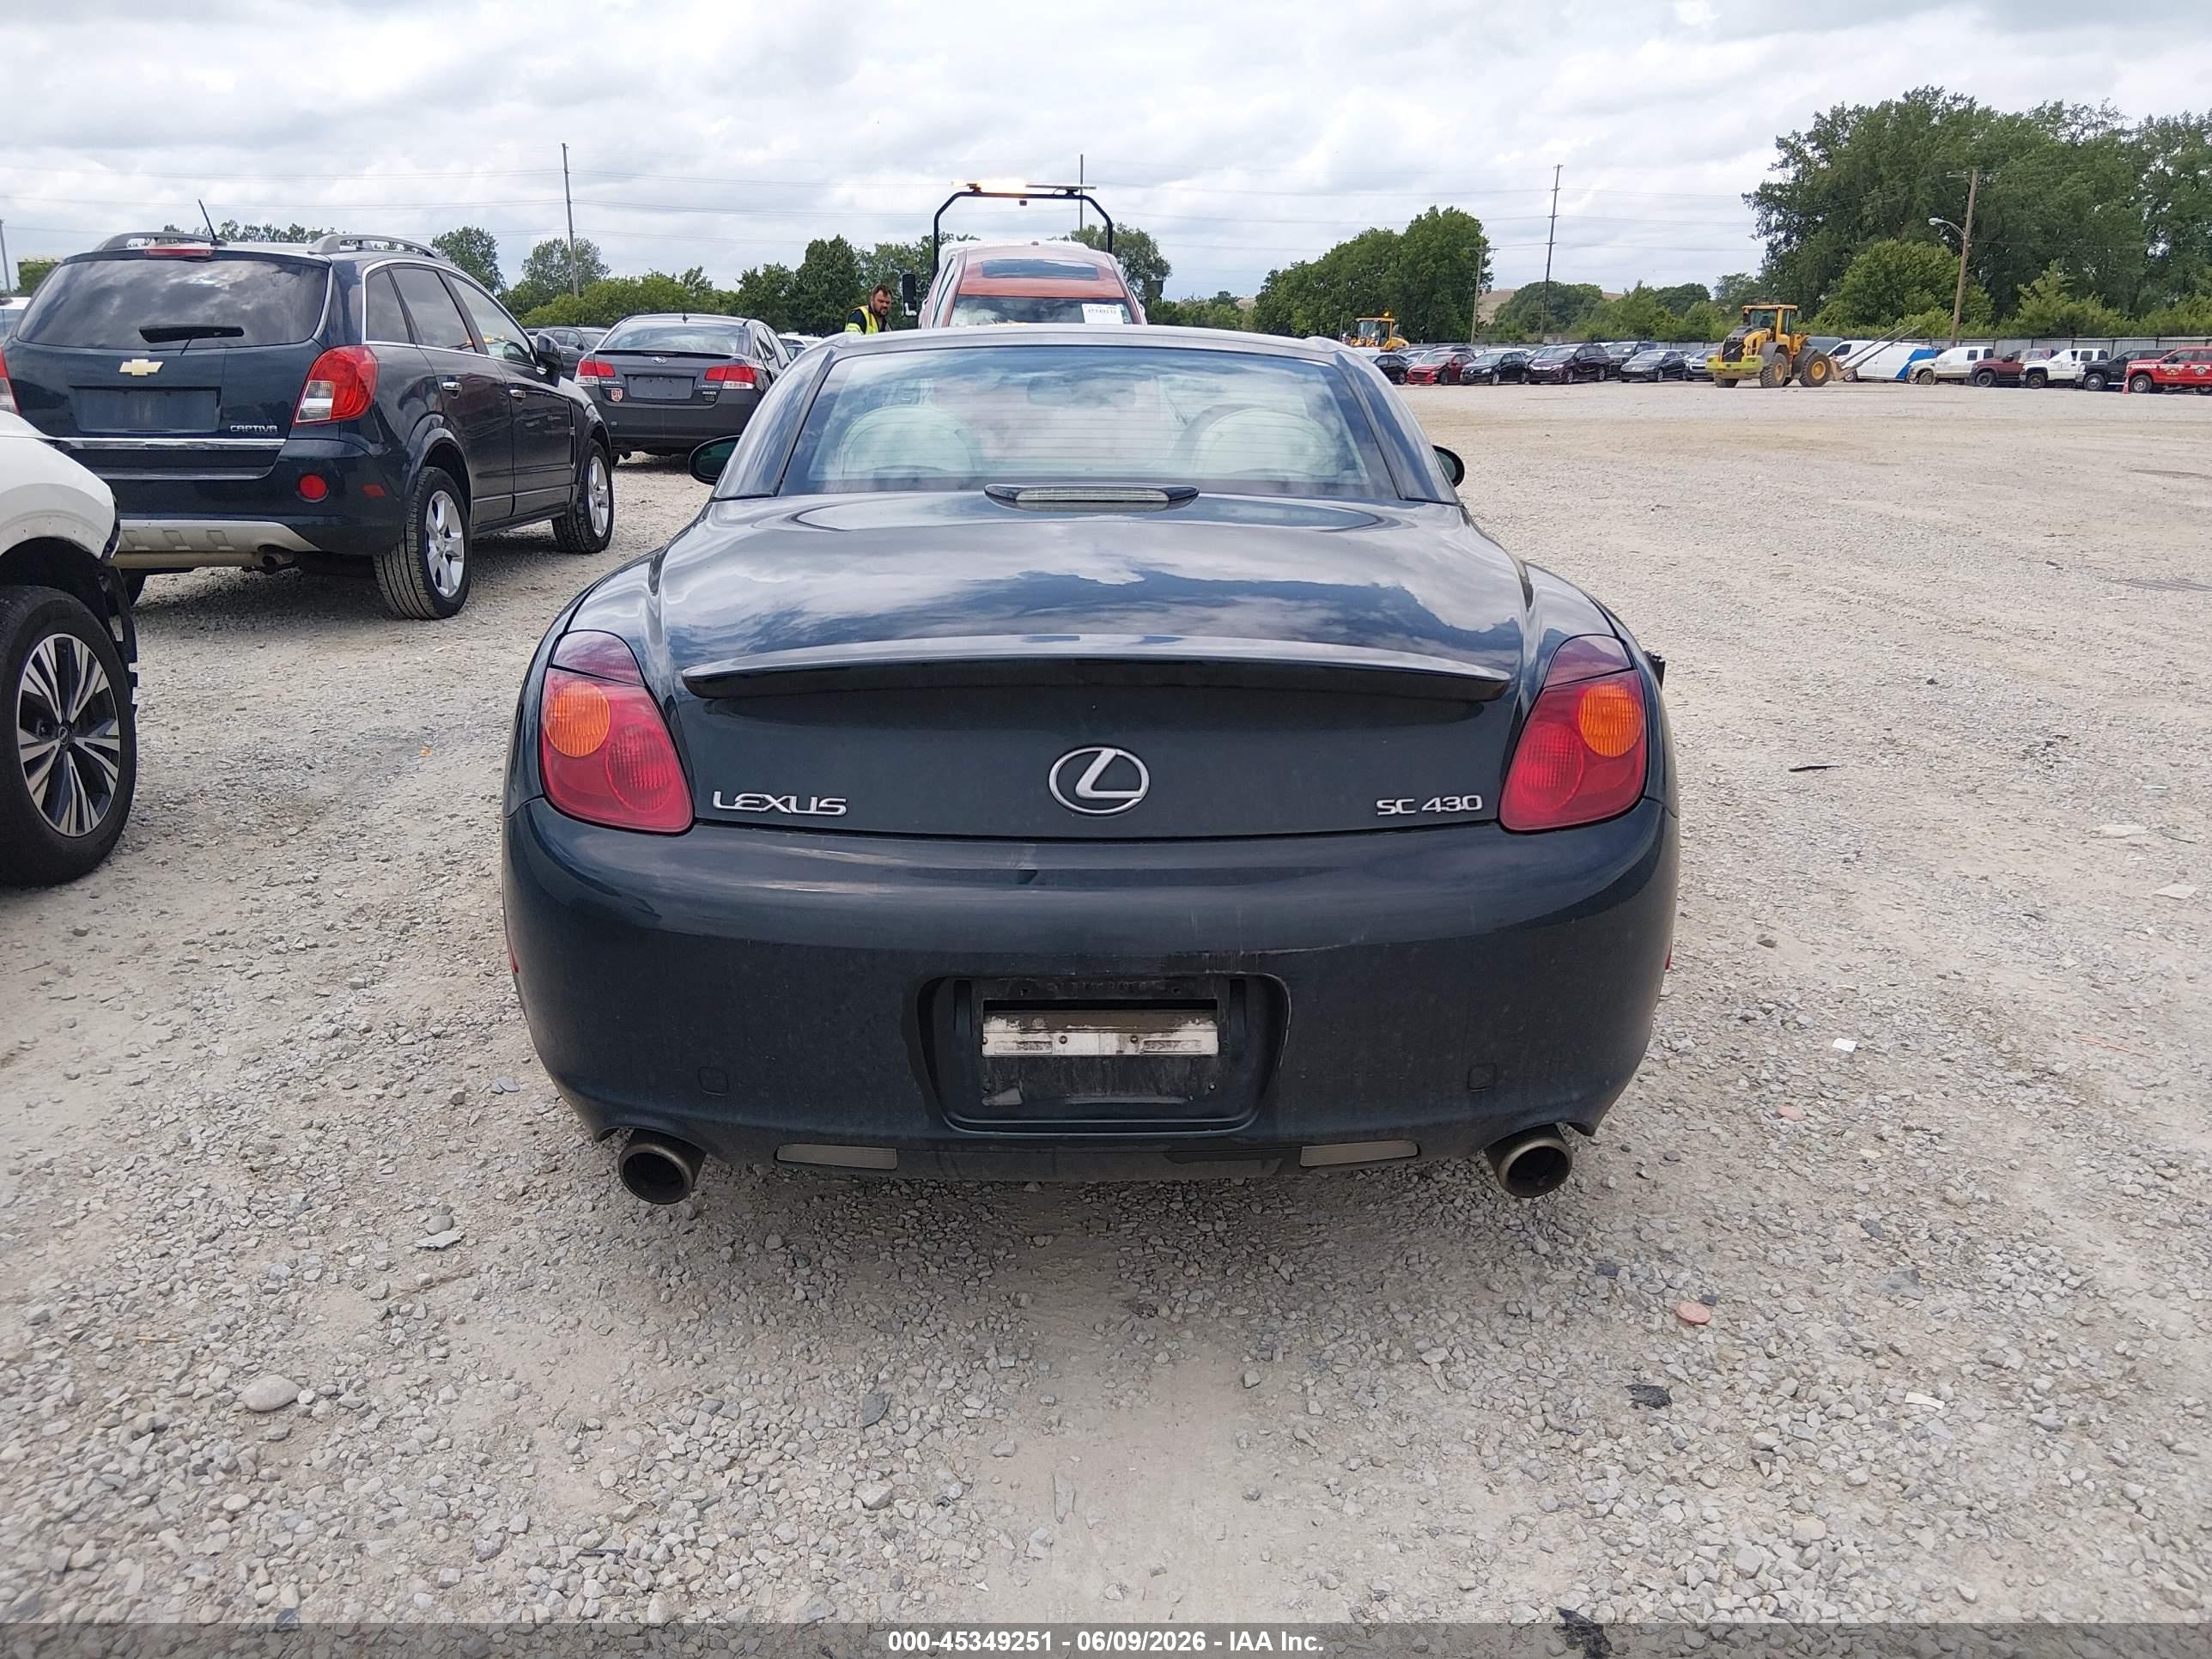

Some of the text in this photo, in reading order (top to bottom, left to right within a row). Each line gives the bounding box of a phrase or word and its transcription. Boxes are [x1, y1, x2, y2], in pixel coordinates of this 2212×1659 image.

[713, 791, 848, 816] LEXUS
[1376, 794, 1483, 816] SC 430
